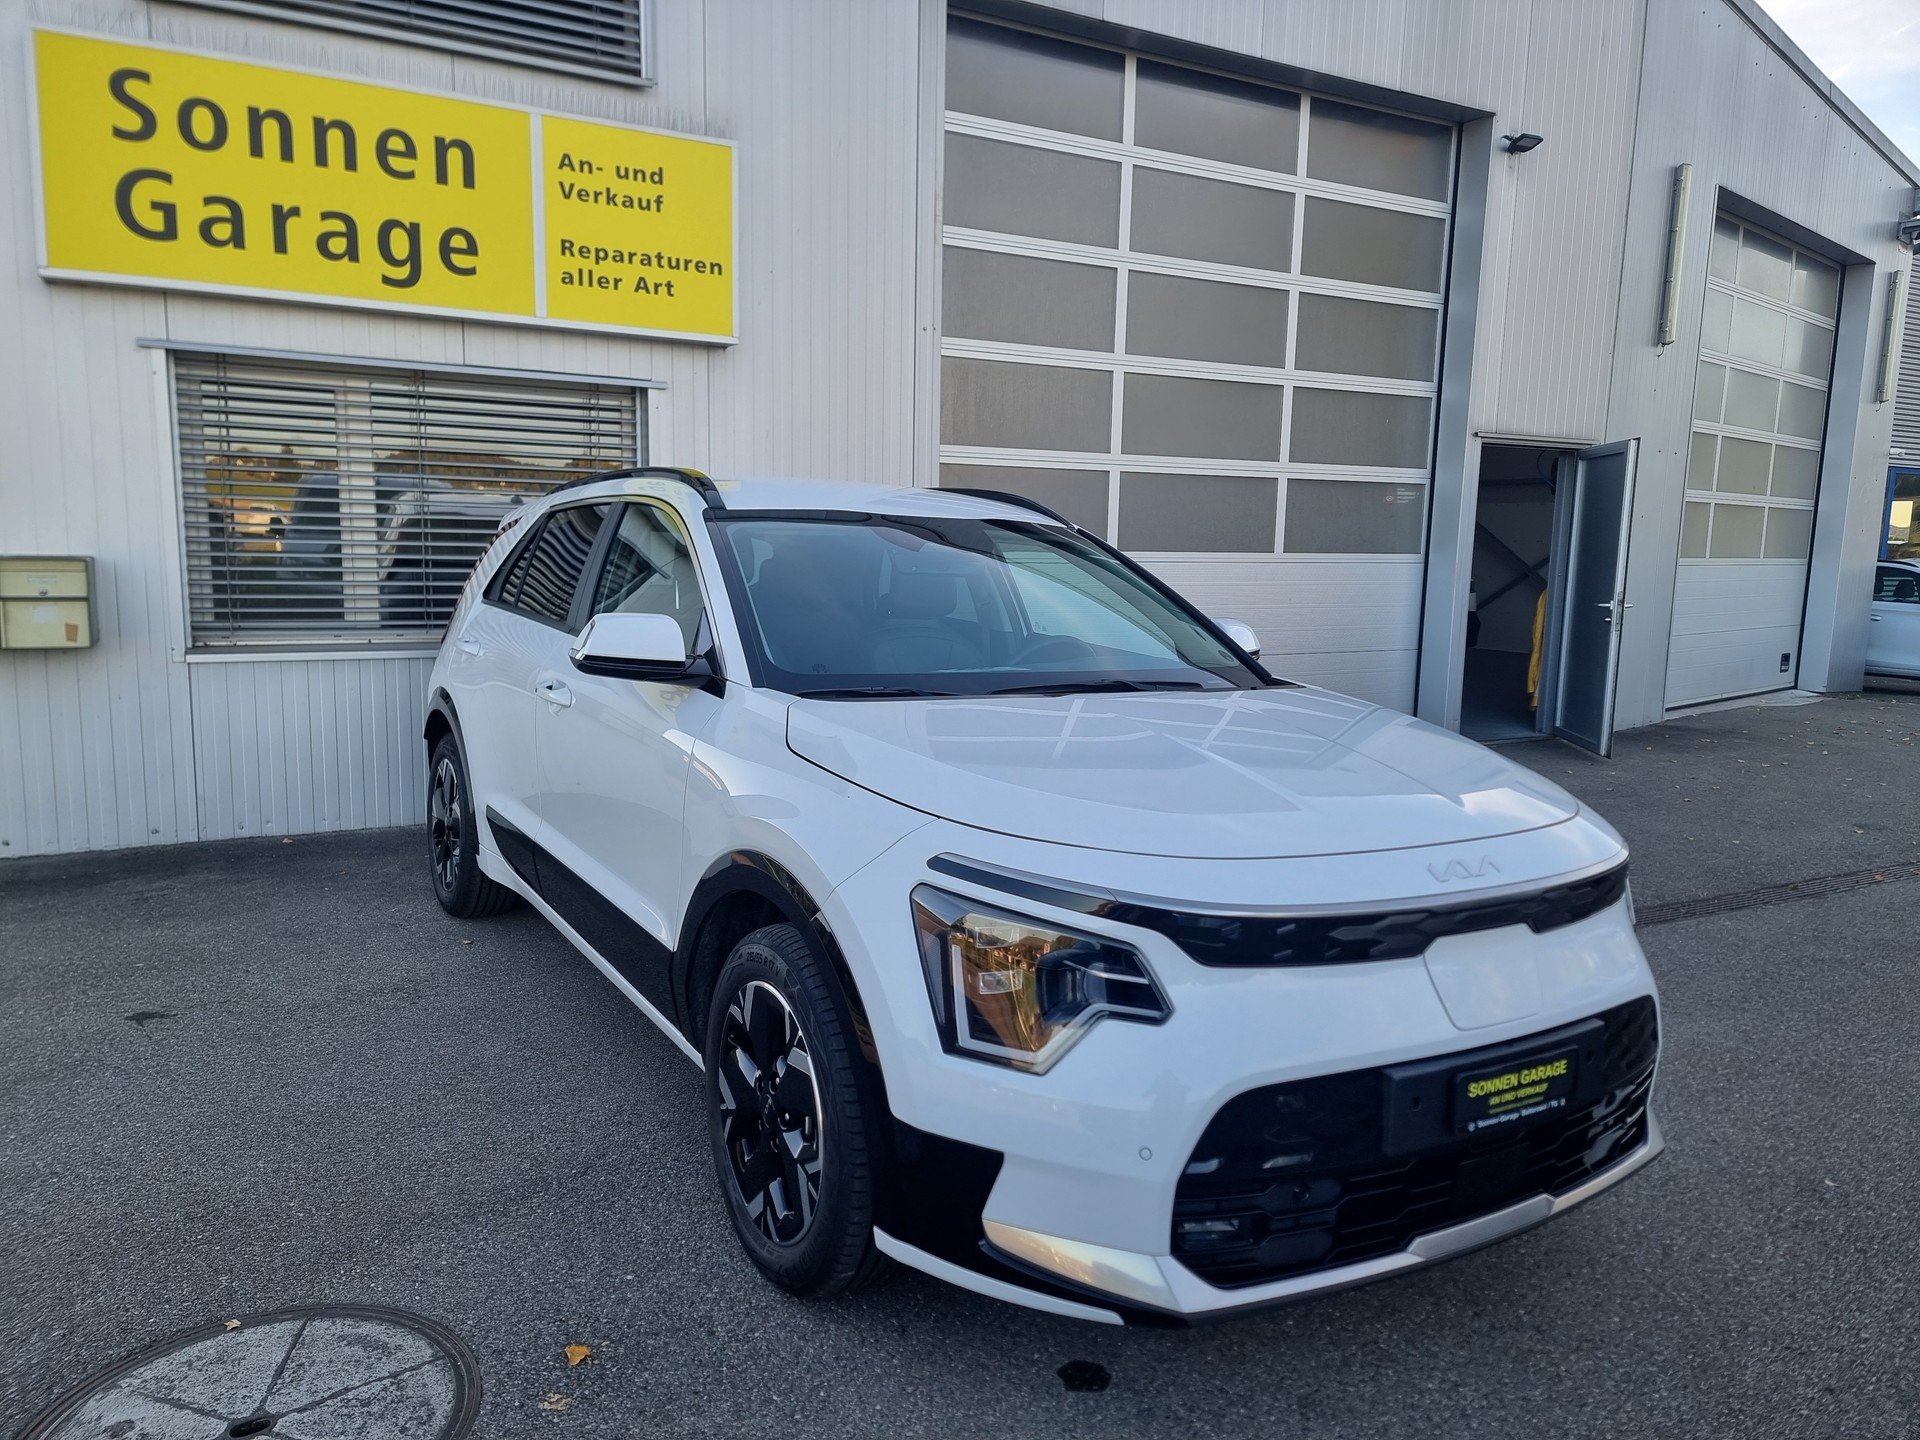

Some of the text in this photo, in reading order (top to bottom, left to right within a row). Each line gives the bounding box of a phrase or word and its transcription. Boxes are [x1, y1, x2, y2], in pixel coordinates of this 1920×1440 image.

[108, 67, 477, 190] Sonnen
[557, 152, 664, 186] An- und
[558, 180, 664, 214] Verkauf
[114, 168, 480, 290] Garage
[560, 238, 723, 276] Reparaturen
[560, 267, 675, 298] aller Art
[1467, 1059, 1568, 1098] SONNEN GARAGE
[1489, 1095, 1500, 1106] AN
[1501, 1091, 1517, 1103] UND
[1517, 1082, 1549, 1099] VERKAUF
